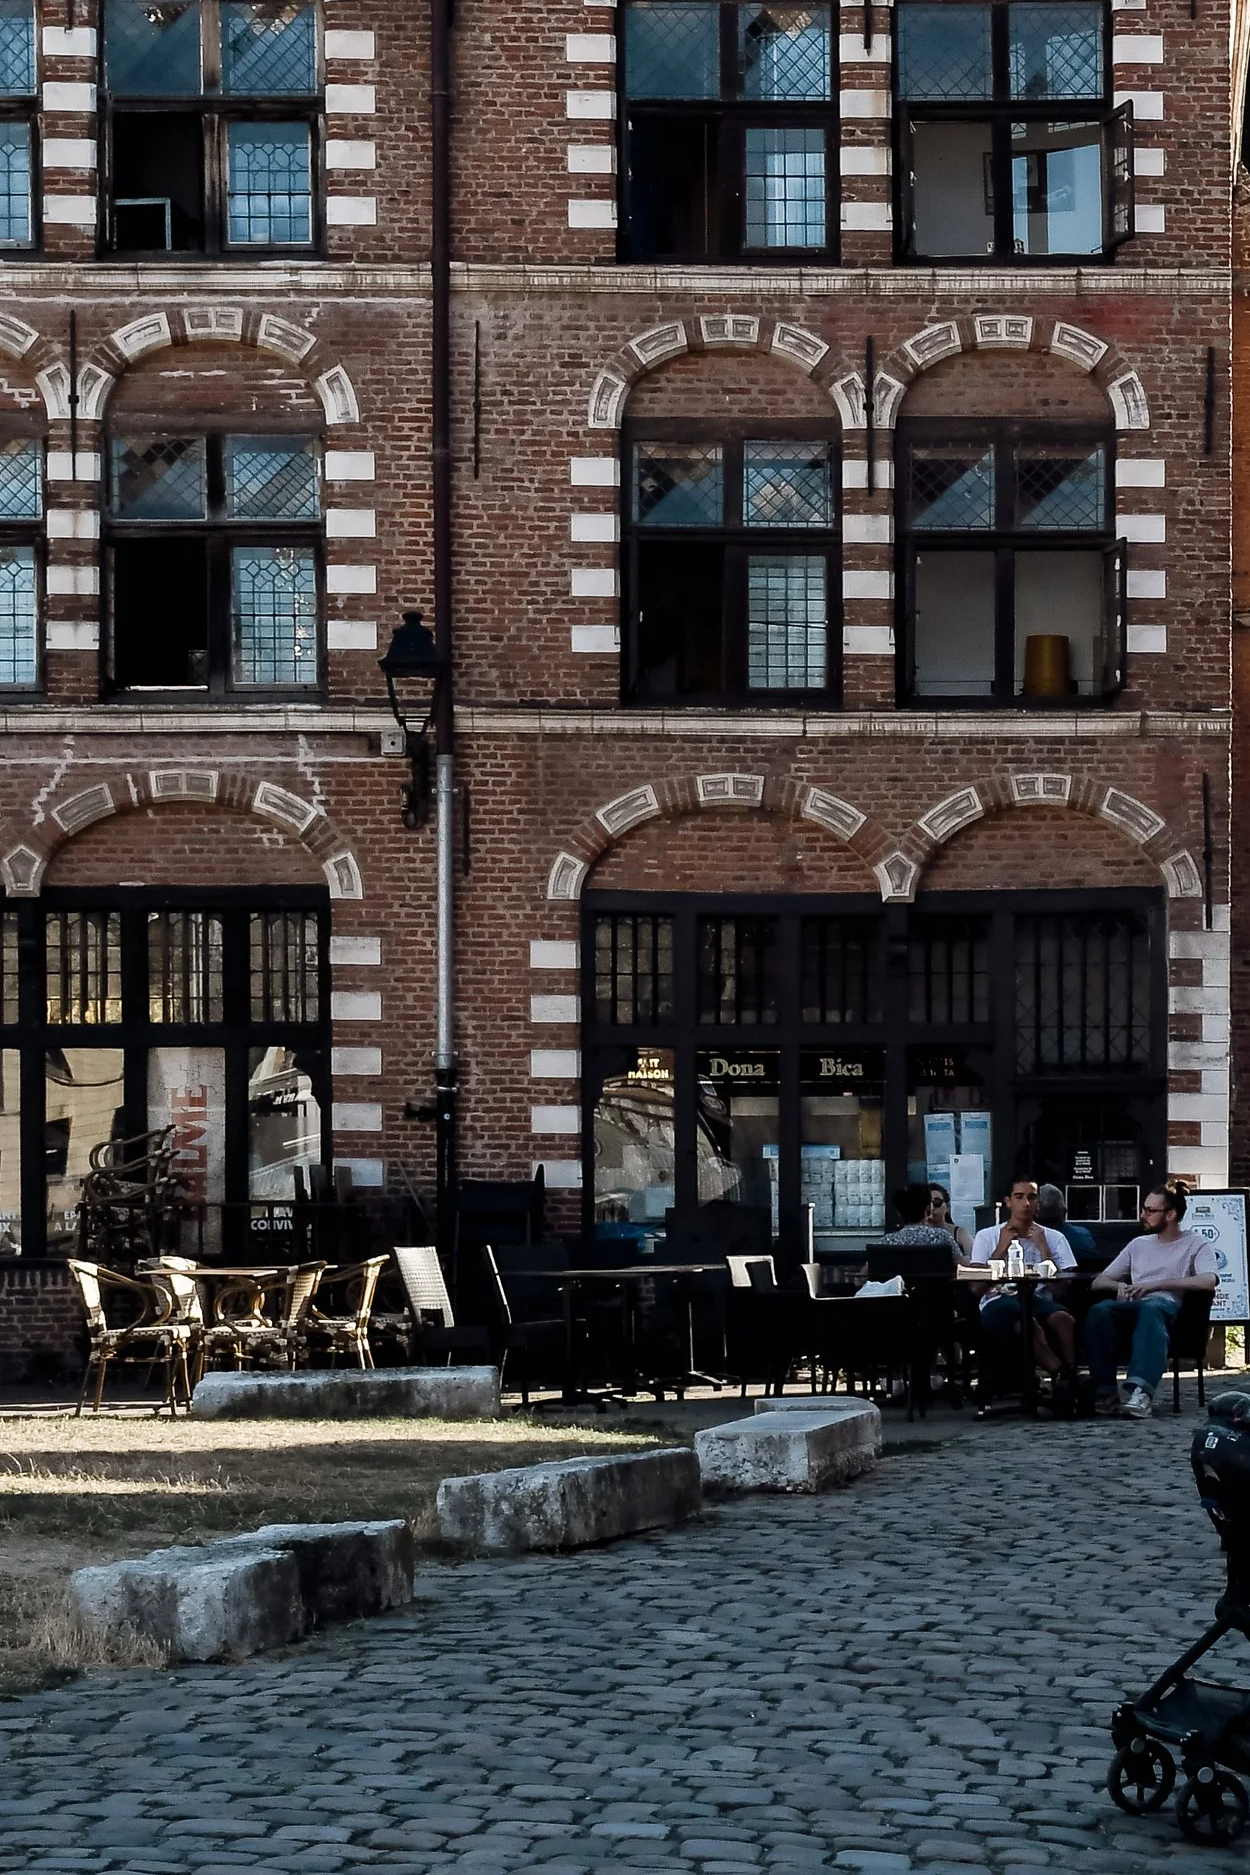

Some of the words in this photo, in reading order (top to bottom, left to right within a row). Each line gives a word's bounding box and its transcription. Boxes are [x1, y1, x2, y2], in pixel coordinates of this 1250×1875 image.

[628, 1069, 669, 1079] MAISON
[709, 1058, 766, 1077] Dona
[819, 1057, 864, 1077] Bica
